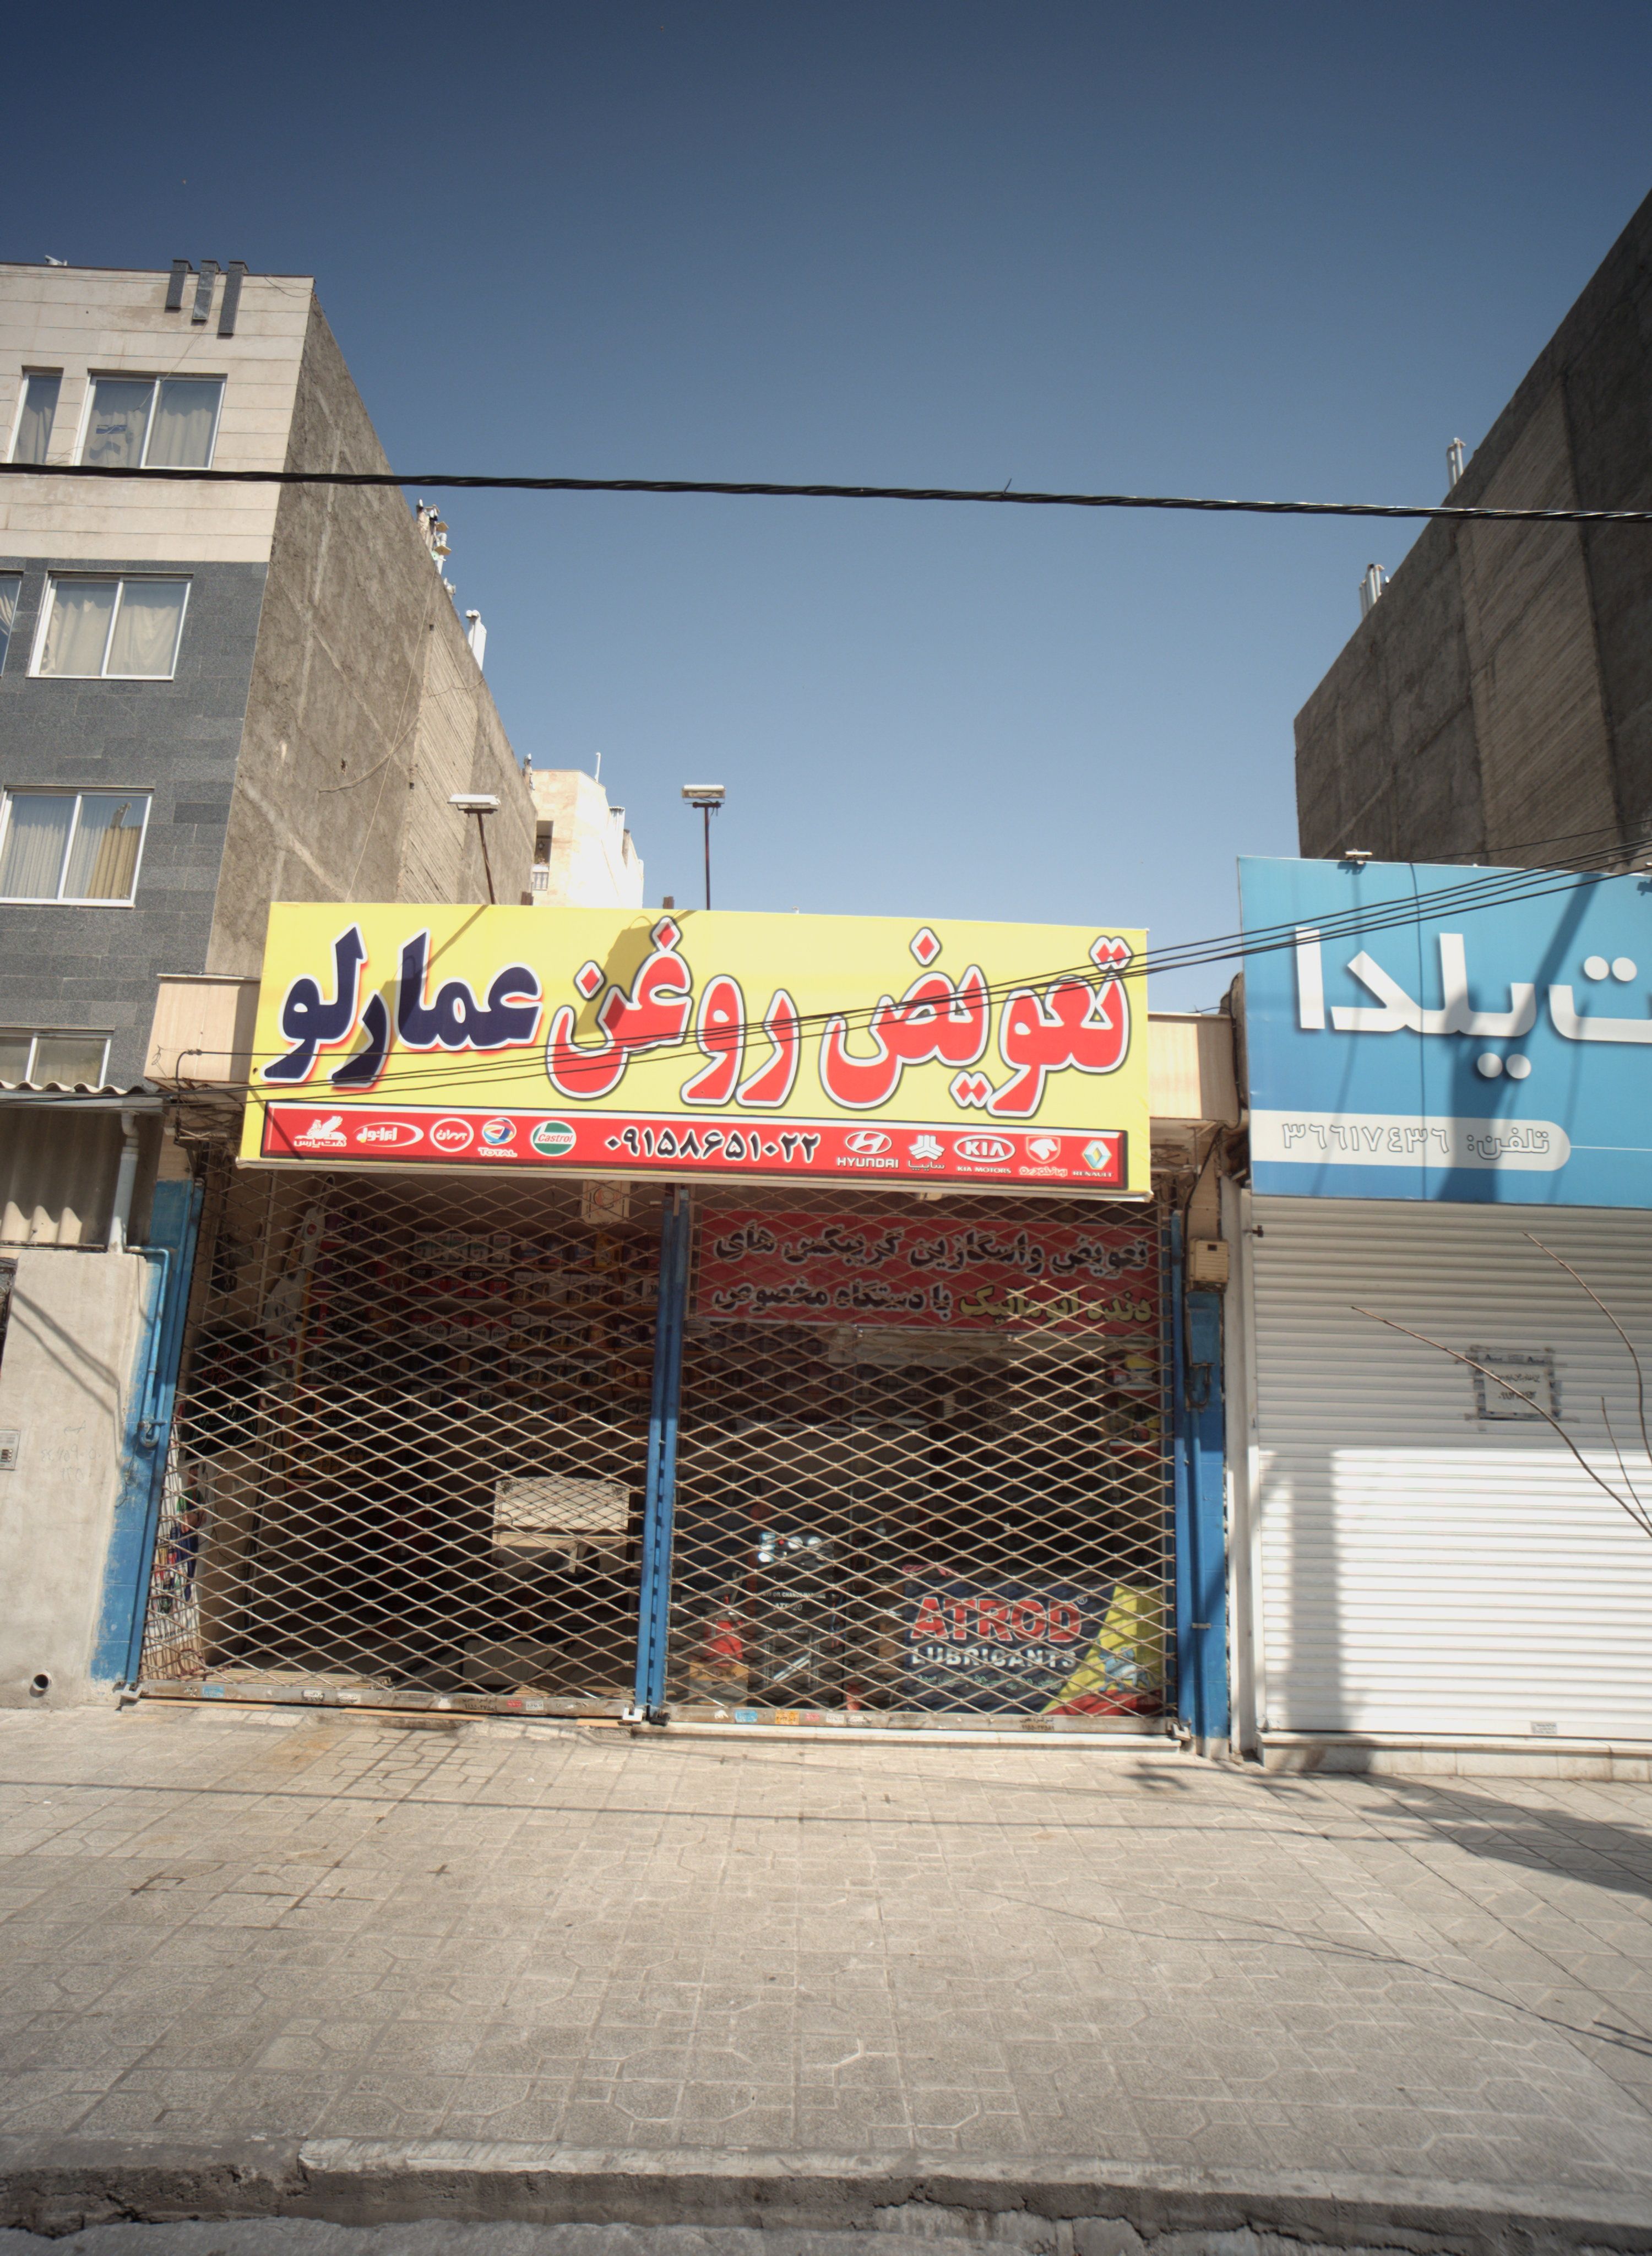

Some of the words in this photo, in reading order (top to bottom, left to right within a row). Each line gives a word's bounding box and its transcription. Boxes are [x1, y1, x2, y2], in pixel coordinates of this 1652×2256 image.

[261, 923, 542, 1088] عمارلو
[547, 916, 799, 1109] روغن
[1295, 927, 1537, 1080] یلدا
[819, 927, 1132, 1118] تعویض
[479, 1147, 517, 1157] TOTAL
[537, 1134, 573, 1143] Castrol
[605, 1125, 821, 1163] ۰۹۱۵۸۶۵۱۰۲۲
[965, 1141, 1006, 1157] KIA
[836, 1157, 899, 1168] HYUNDAI
[907, 1159, 945, 1172] سایپا
[974, 1166, 1012, 1174] MOTORS
[1051, 1236, 1149, 1279] تعویض
[930, 1282, 953, 1321] با
[1087, 1290, 1153, 1322] دنده
[910, 1596, 1082, 1643] ATROD
[912, 1647, 1077, 1668] LUBRICANTS
